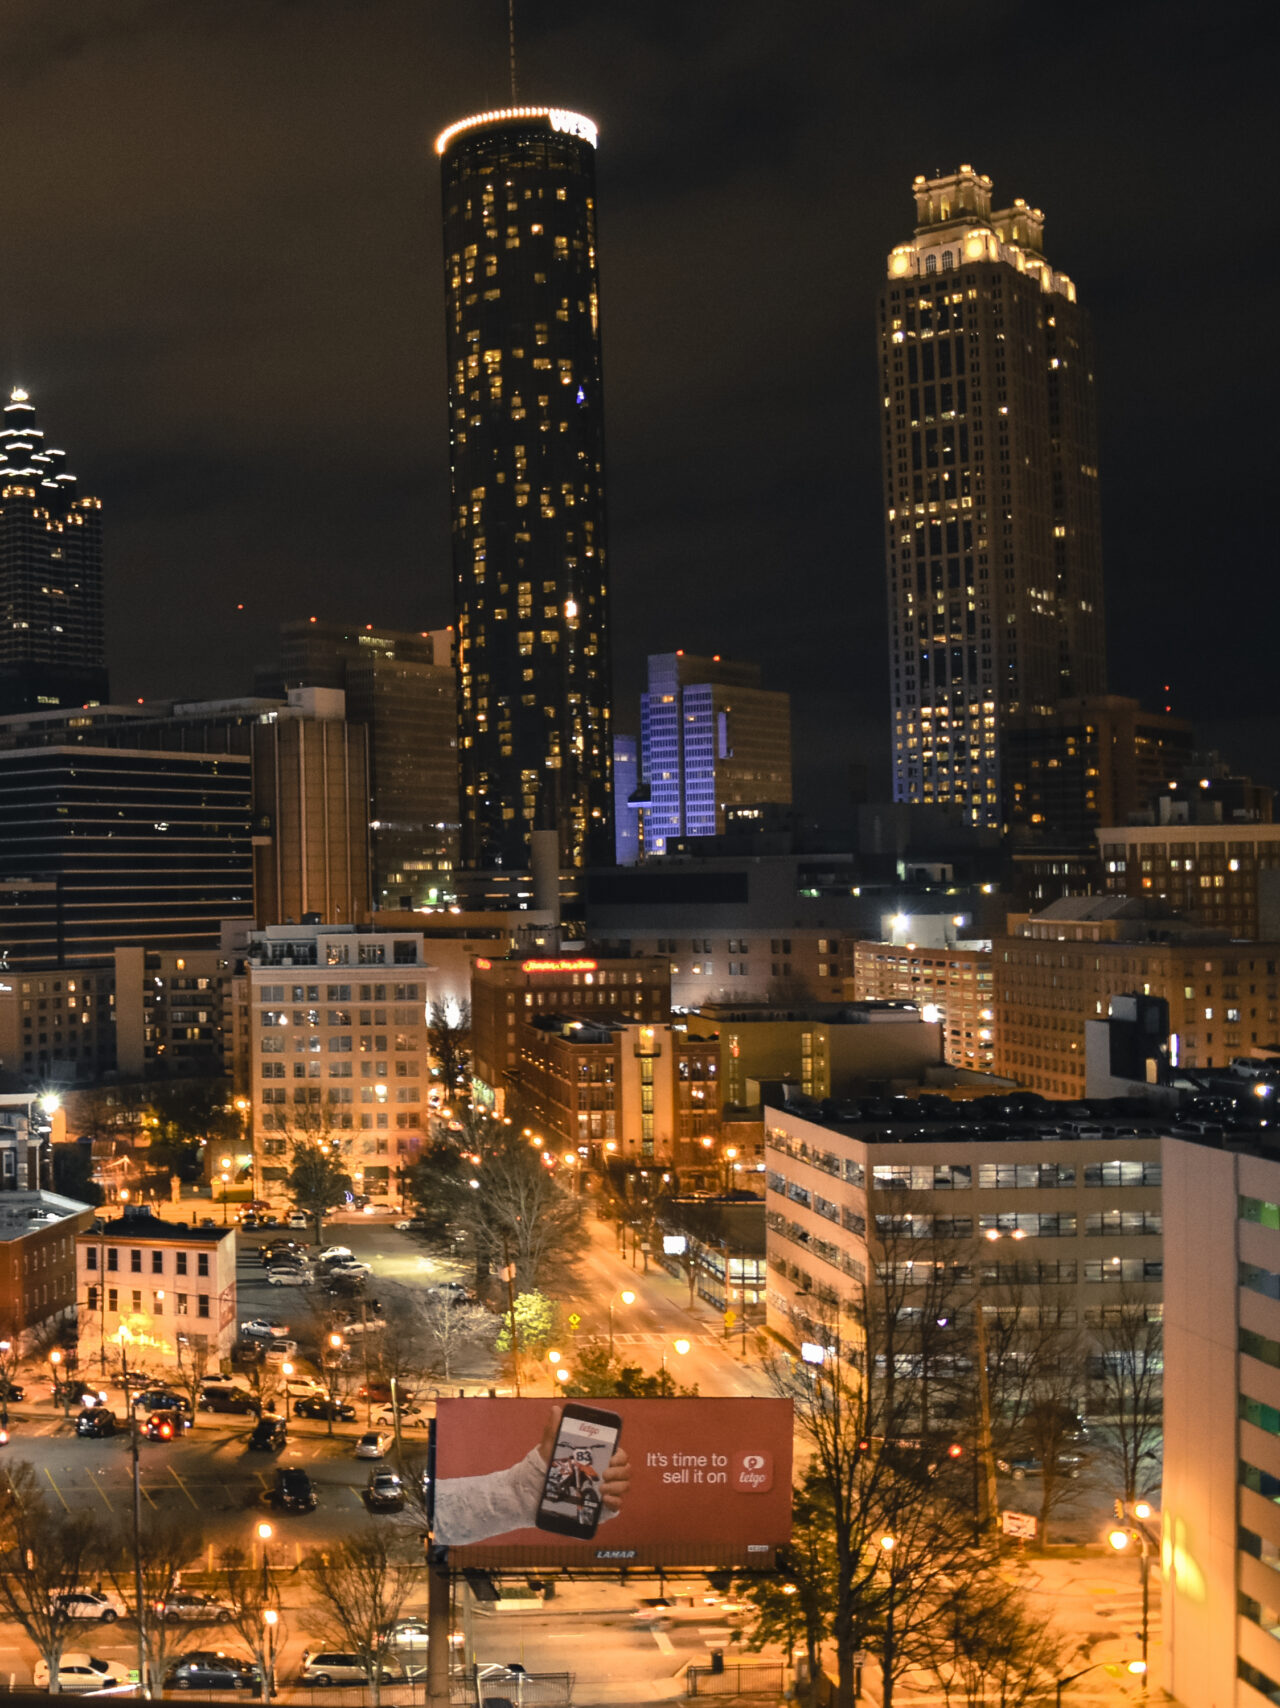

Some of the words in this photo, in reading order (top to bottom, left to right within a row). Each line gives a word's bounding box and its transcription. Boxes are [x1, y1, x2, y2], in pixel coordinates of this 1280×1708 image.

[576, 1450, 592, 1462] 83
[646, 1452, 668, 1467] It's
[672, 1452, 708, 1467] time
[711, 1453, 728, 1467] to
[663, 1469, 689, 1484] sell
[693, 1469, 703, 1484] it
[706, 1472, 726, 1484] on
[739, 1472, 766, 1488] letgo
[597, 1551, 636, 1559] LAMAR
